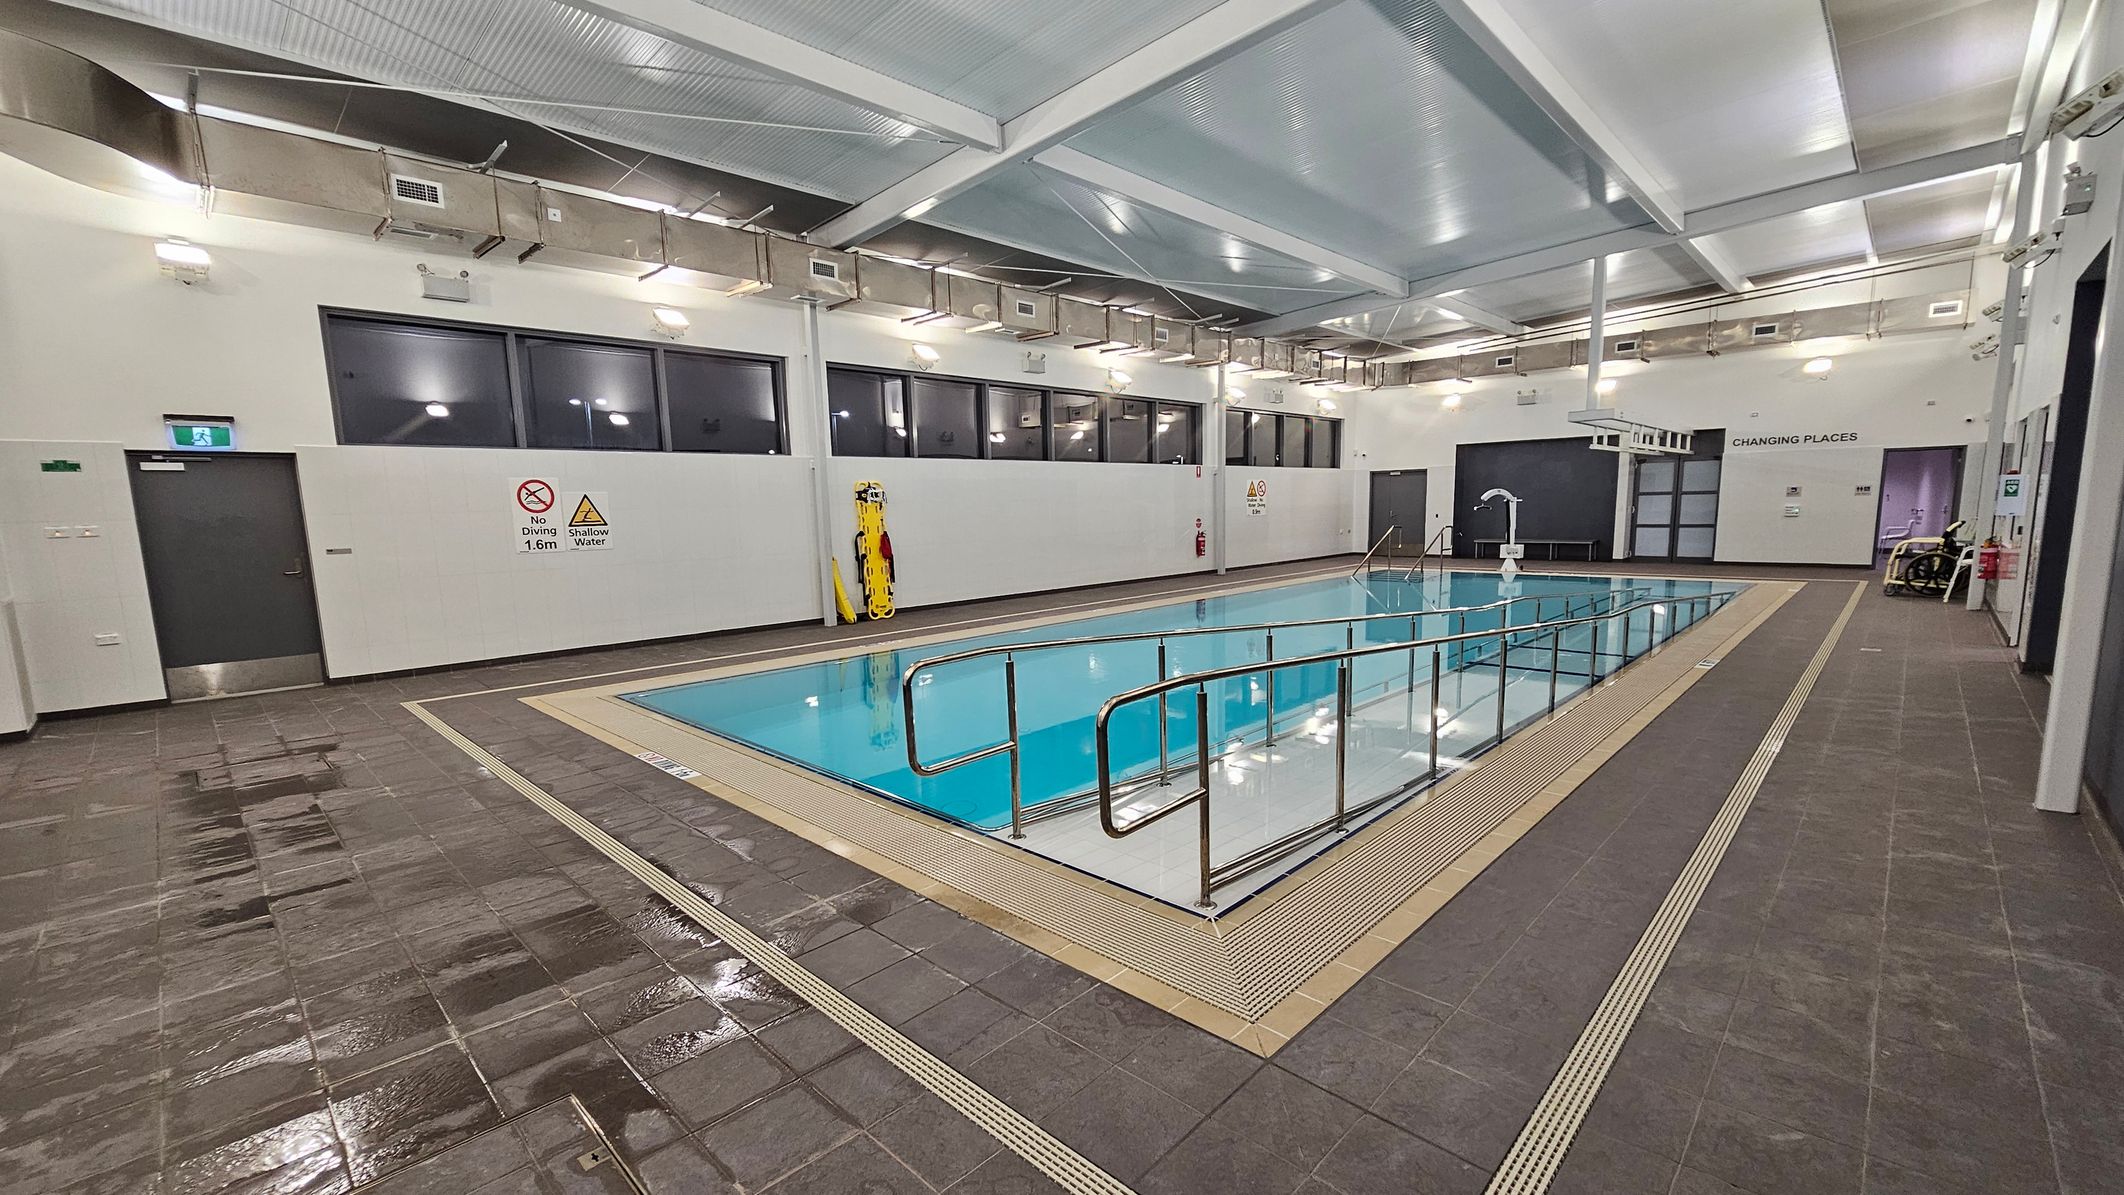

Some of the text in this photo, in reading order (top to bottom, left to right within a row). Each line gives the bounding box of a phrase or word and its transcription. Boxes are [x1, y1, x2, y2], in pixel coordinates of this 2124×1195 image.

[1732, 432, 1858, 447] CHANGING PLACES
[530, 516, 547, 524] No
[522, 526, 557, 536] Diving
[568, 528, 609, 537] Shallow
[524, 540, 557, 550] 1.6m
[574, 538, 606, 546] Water
